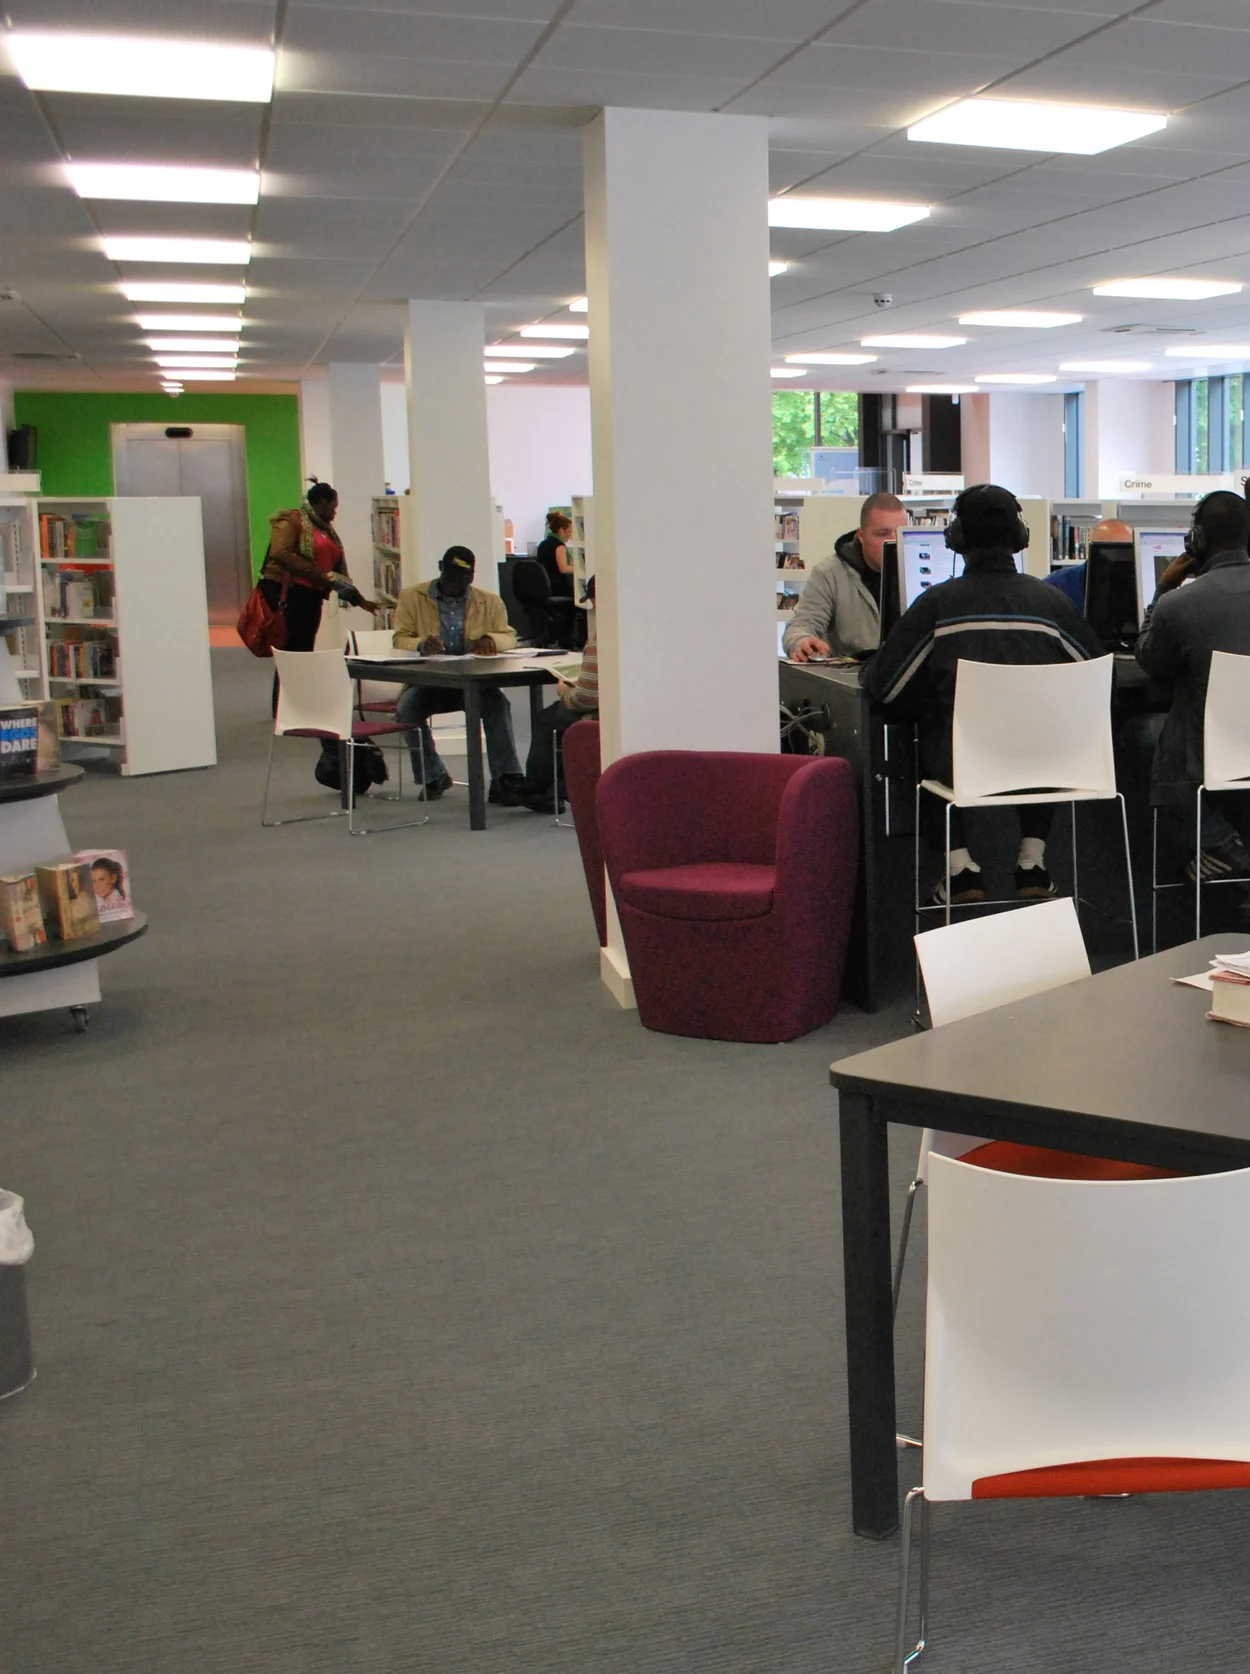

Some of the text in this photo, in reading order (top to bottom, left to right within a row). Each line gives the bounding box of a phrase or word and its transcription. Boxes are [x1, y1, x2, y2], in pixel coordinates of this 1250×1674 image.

[1124, 479, 1152, 489] Crime
[0, 717, 37, 729] WHERE
[1, 738, 37, 753] DARE
